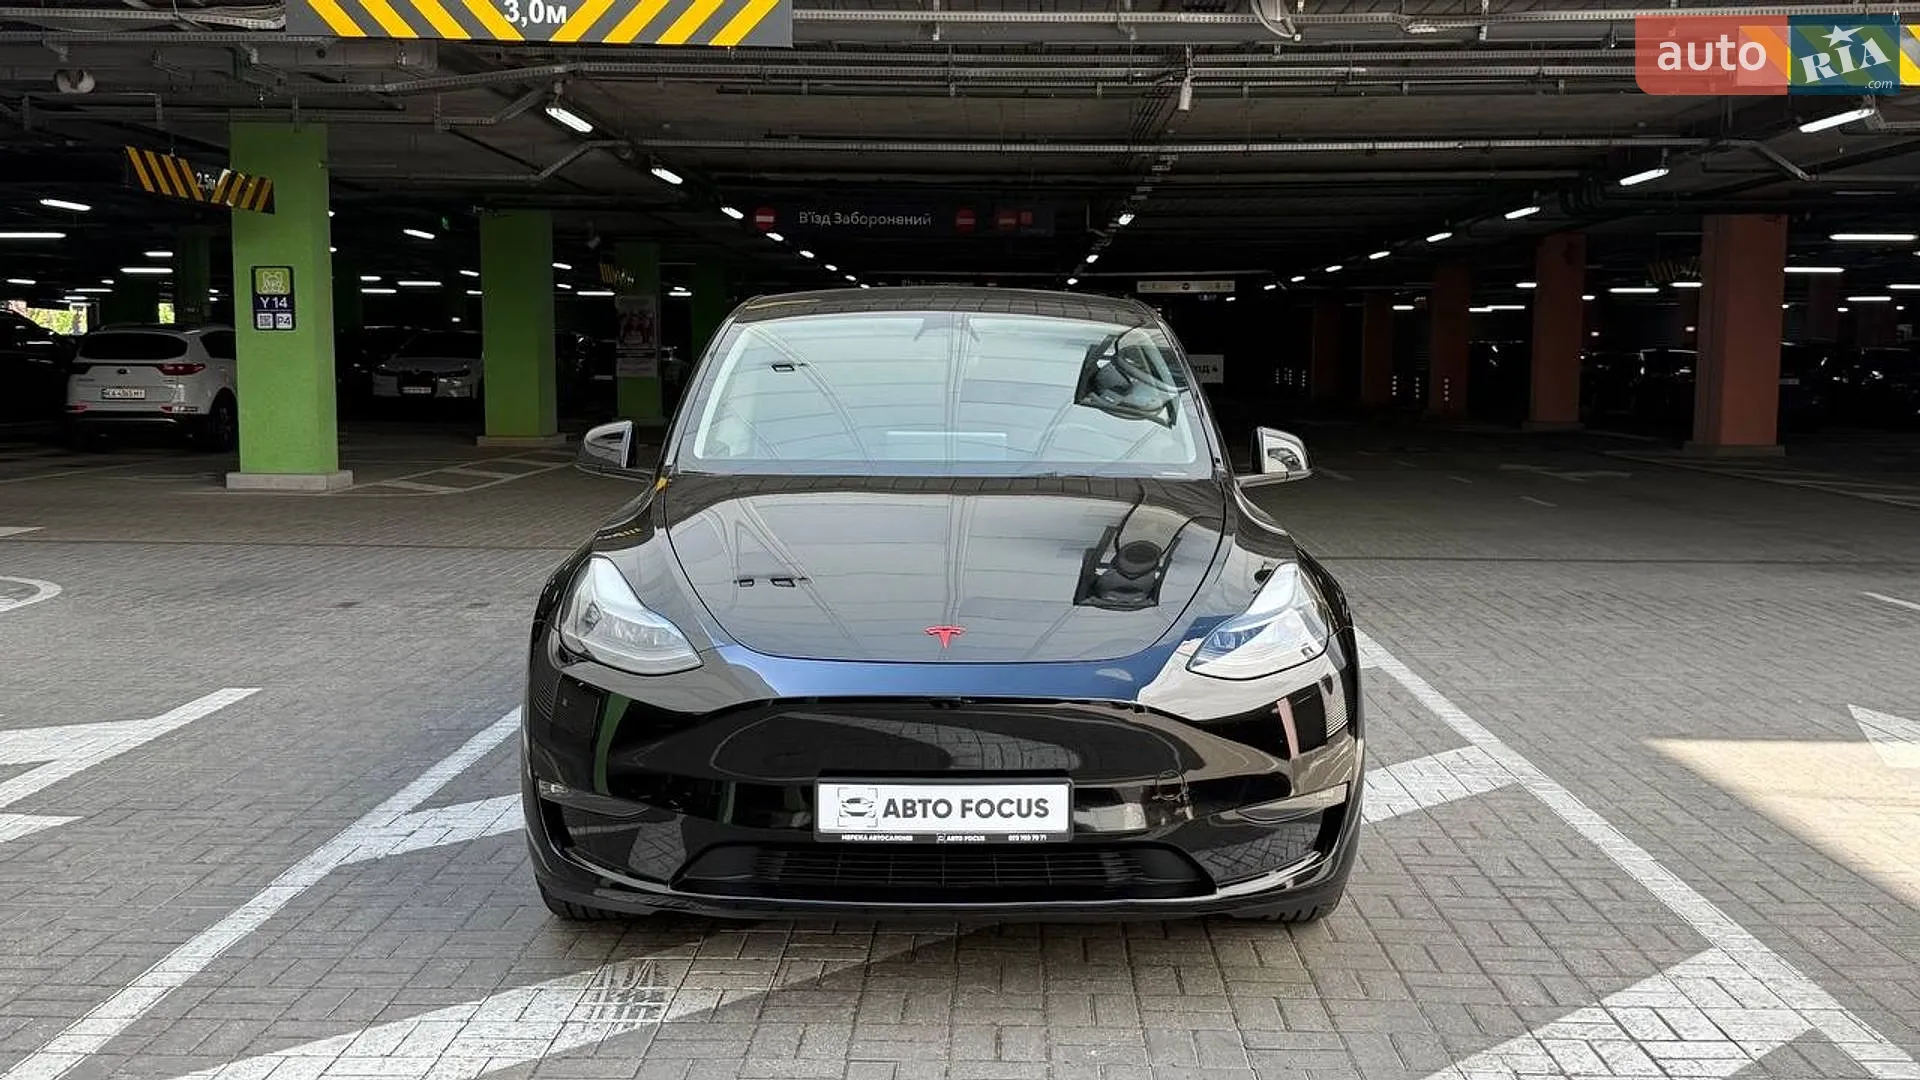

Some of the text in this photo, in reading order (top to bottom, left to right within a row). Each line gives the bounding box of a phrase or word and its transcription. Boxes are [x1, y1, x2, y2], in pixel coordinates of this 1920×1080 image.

[272, 296, 288, 308] 14
[882, 797, 1050, 819] АВТО FOCUS
